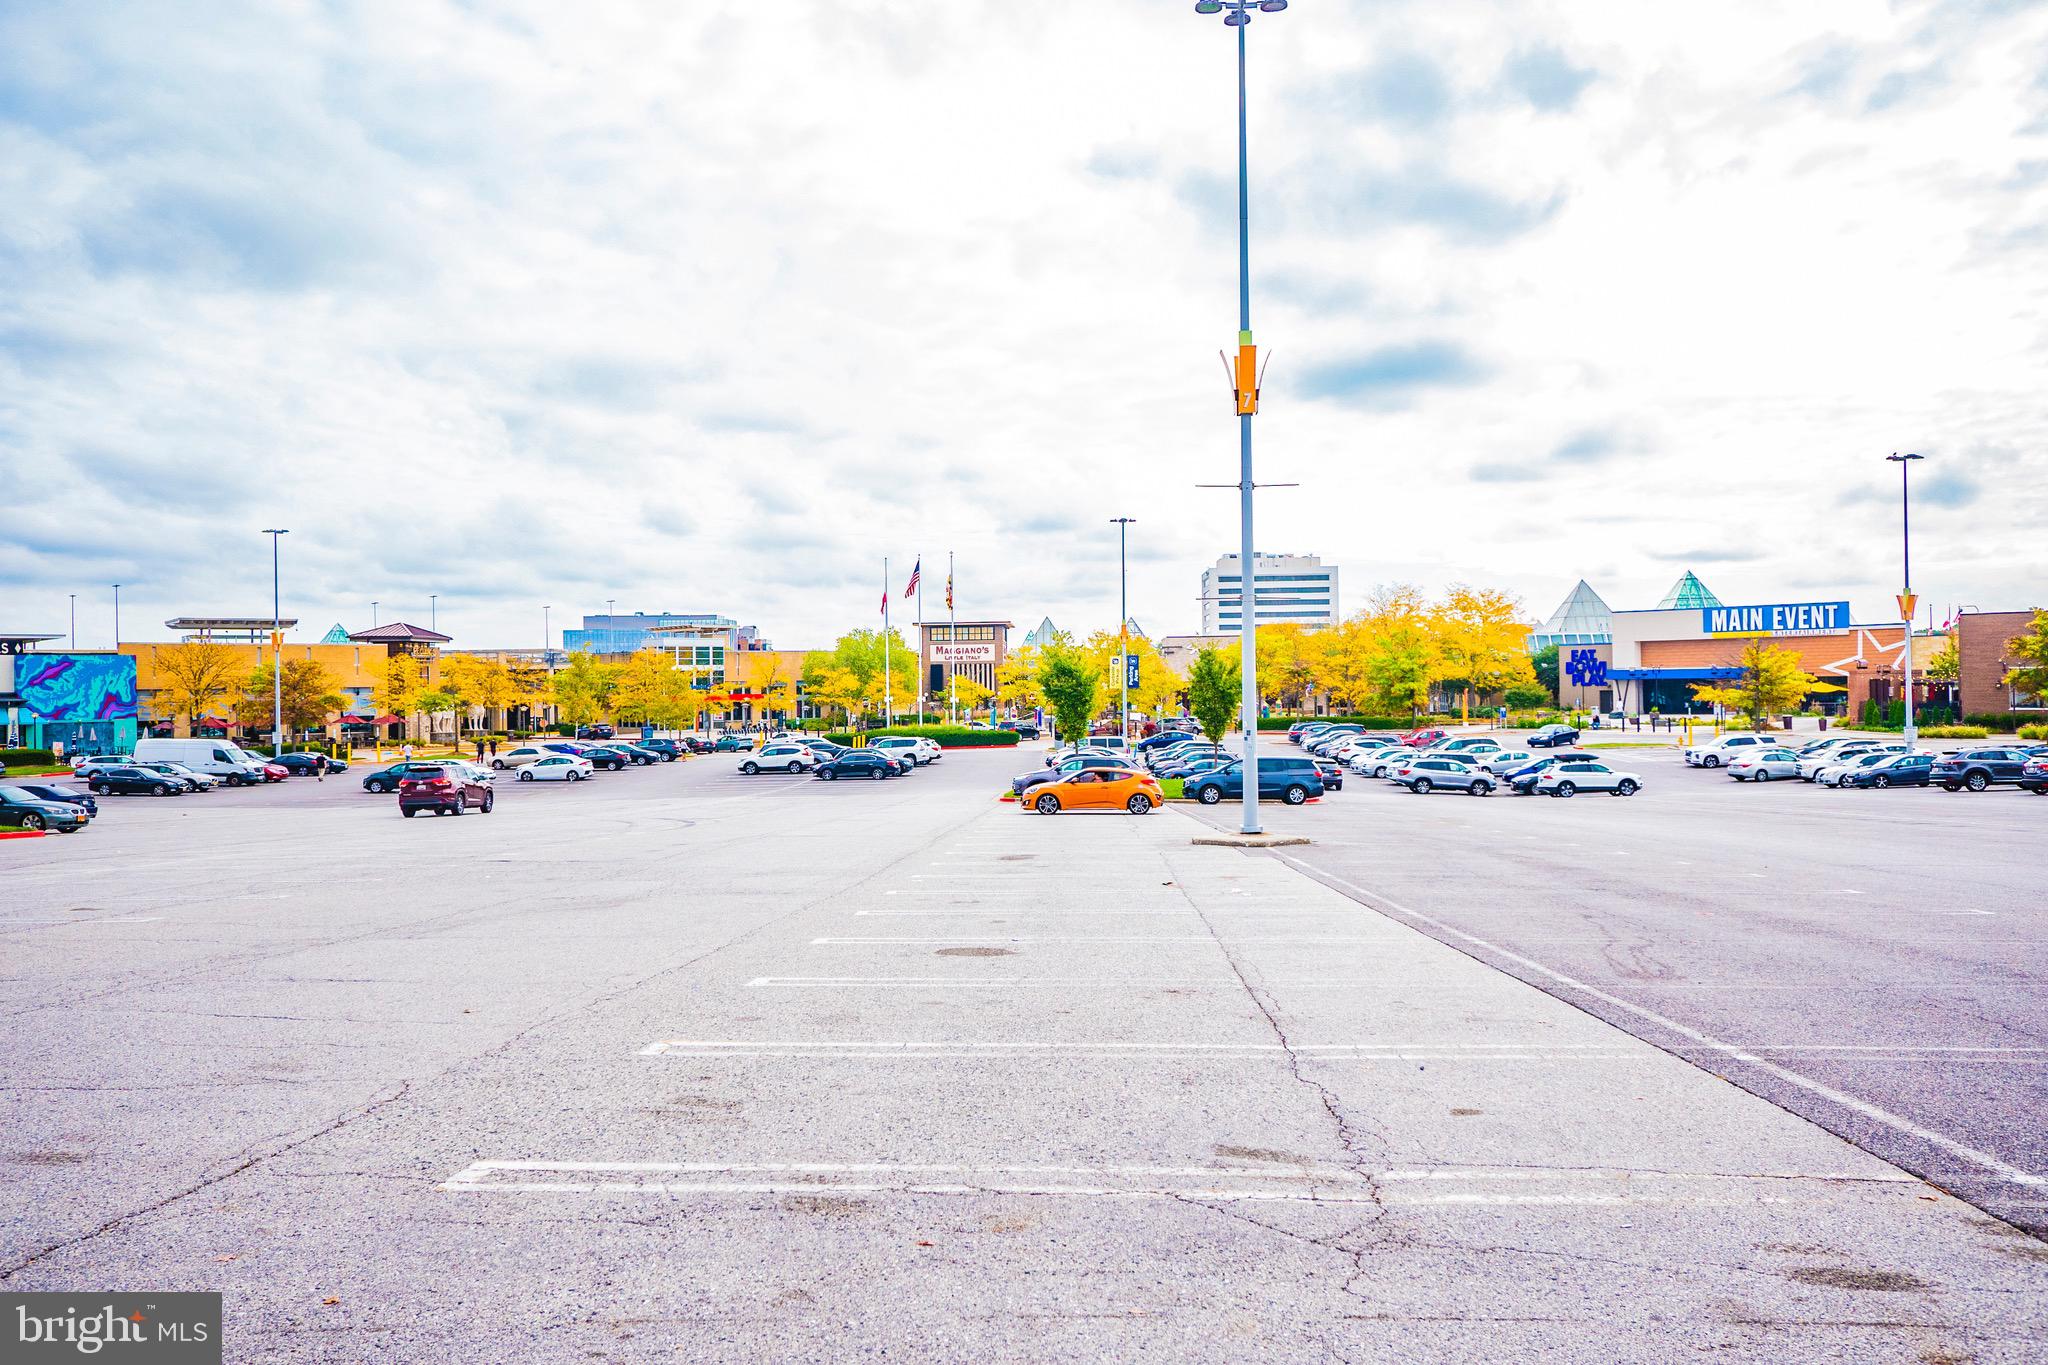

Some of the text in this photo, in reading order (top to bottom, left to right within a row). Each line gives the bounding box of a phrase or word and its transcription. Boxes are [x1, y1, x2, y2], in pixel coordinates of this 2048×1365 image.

[1243, 392, 1252, 408] 7
[1711, 605, 1838, 632] MAIN EVENT
[1773, 628, 1835, 637] ENTERTAINMENT
